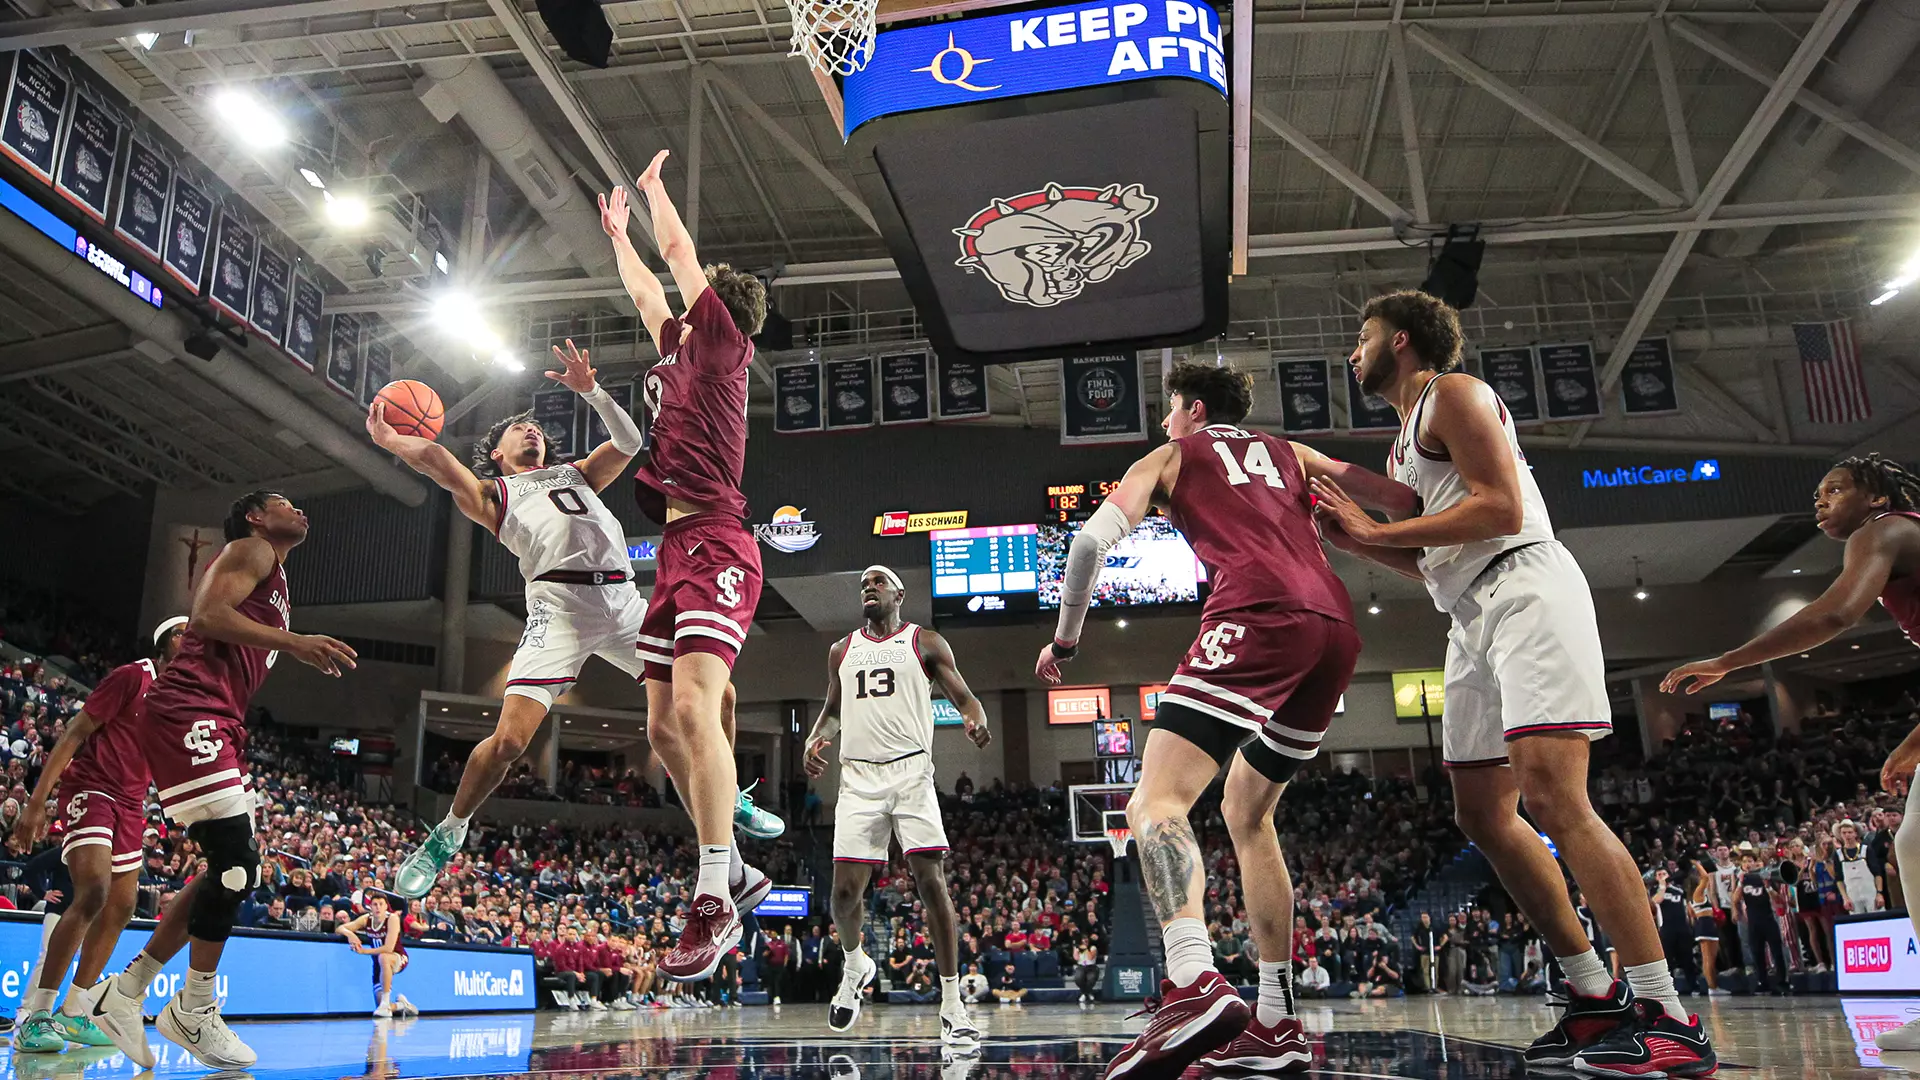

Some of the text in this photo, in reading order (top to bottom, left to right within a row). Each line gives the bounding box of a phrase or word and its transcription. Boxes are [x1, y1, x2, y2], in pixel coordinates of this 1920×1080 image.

[1010, 5, 1148, 52] KEEP
[1107, 36, 1228, 95] AFTE
[28, 75, 51, 99] NCAA
[142, 178, 166, 200] Round
[137, 279, 145, 293] 8
[1072, 355, 1127, 365] BASKETBALL
[1087, 379, 1115, 389] FINAL
[1088, 388, 1115, 400] FOUR
[1211, 440, 1286, 489] 14
[512, 469, 588, 498] ZAGS
[1582, 465, 1688, 488] MultiCare
[1047, 485, 1084, 496] BULLDOGS
[548, 487, 589, 515] 0
[1060, 496, 1078, 509] 82
[884, 513, 907, 531] Tires
[909, 515, 965, 527] LES SCHWAB
[1060, 511, 1067, 521] 3
[752, 523, 817, 542] KALISPEL
[848, 649, 907, 667] ZAGS
[855, 667, 896, 699] 13
[1108, 733, 1128, 753] 12
[1743, 884, 1763, 896] GU
[1846, 945, 1889, 968] BECU
[454, 970, 508, 996] MultiCare
